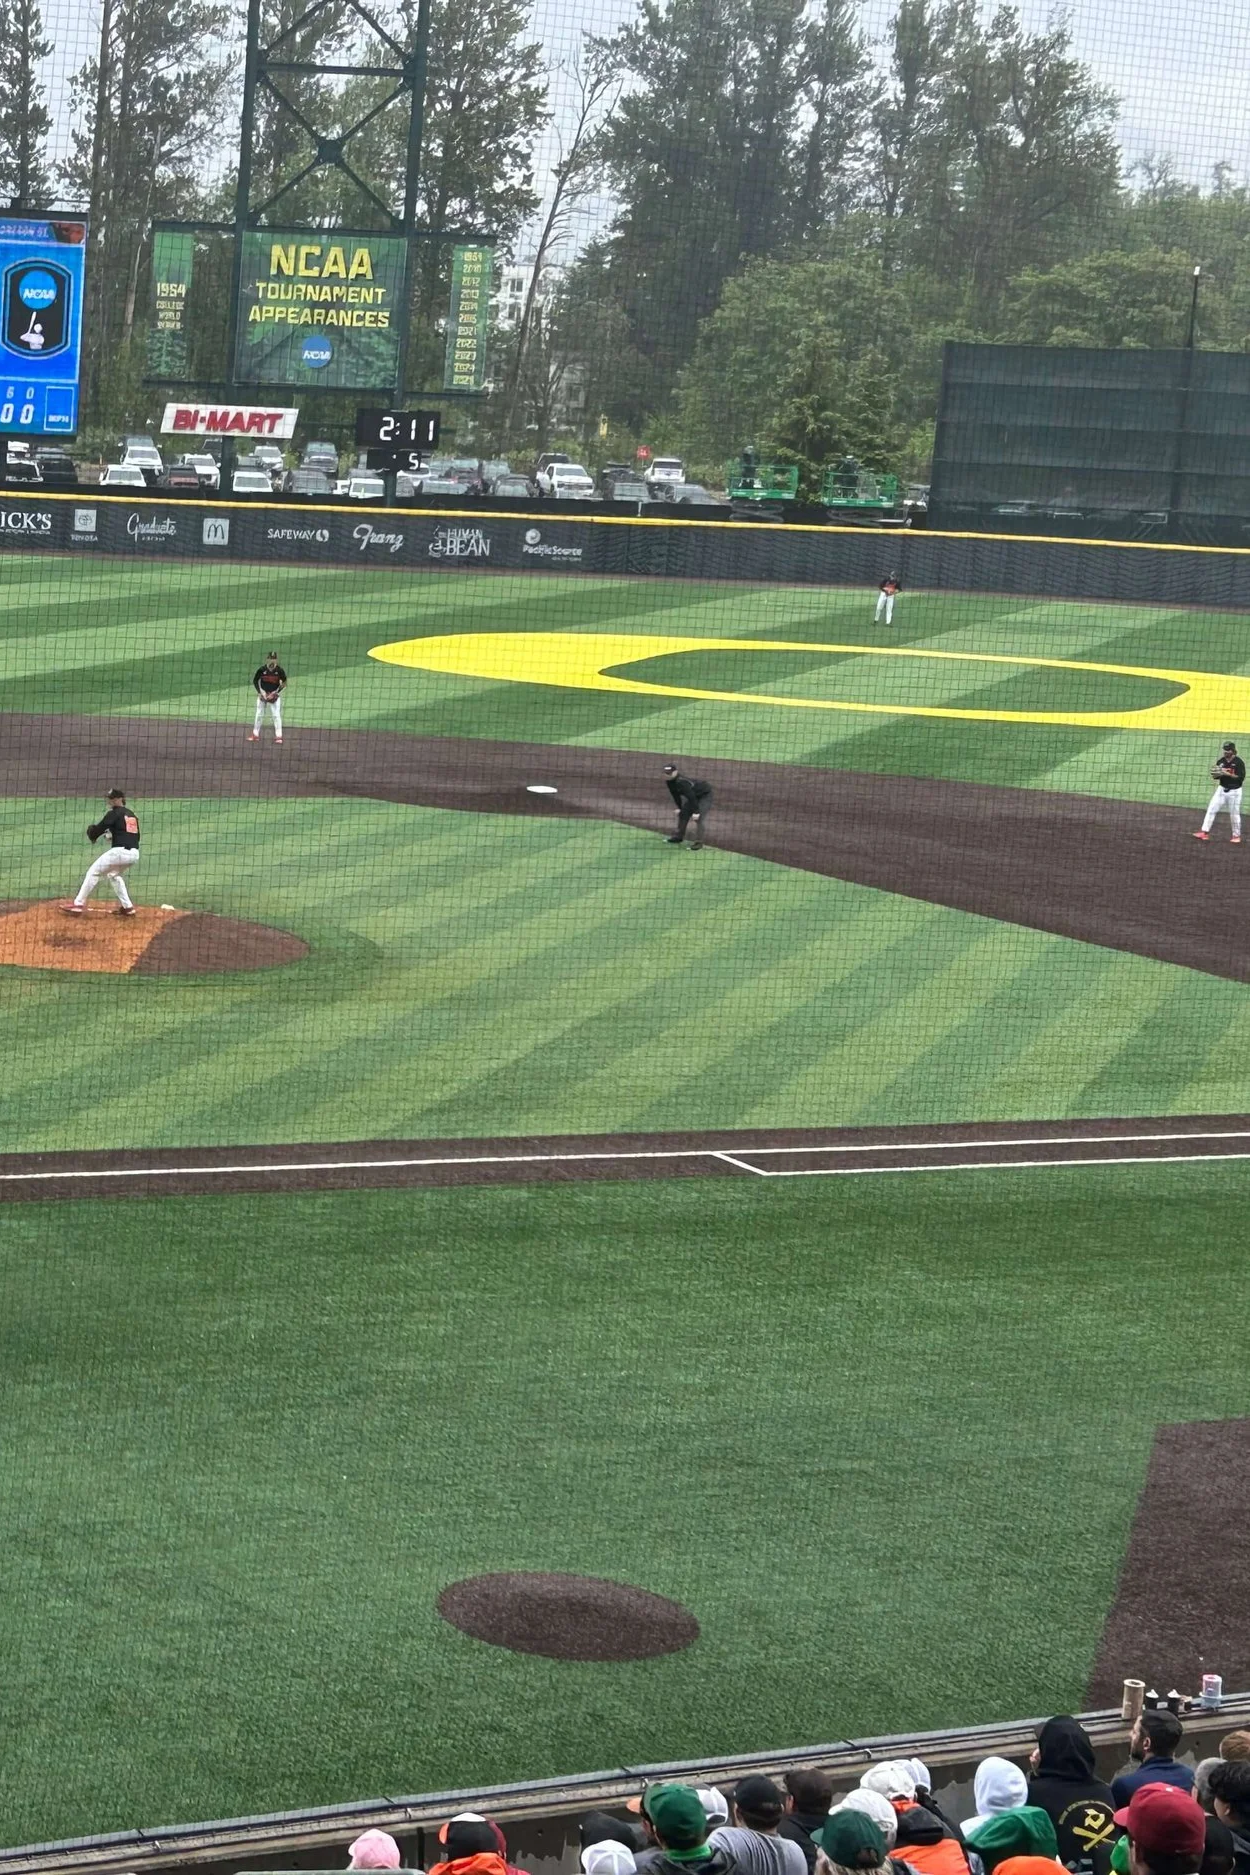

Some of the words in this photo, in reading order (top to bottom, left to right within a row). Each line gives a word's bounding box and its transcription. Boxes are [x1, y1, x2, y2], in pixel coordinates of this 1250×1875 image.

[270, 244, 373, 280] NCAA
[156, 282, 186, 298] 1954
[256, 281, 387, 304] TOURNAMENT
[248, 304, 390, 328] APPEARANCES
[0, 403, 14, 424] 0
[19, 404, 35, 424] 0
[172, 409, 285, 434] BI-MART
[379, 416, 434, 442] 2:11
[408, 453, 420, 470] 5
[267, 528, 315, 541] SAFEWAY
[445, 538, 491, 557] BEAN
